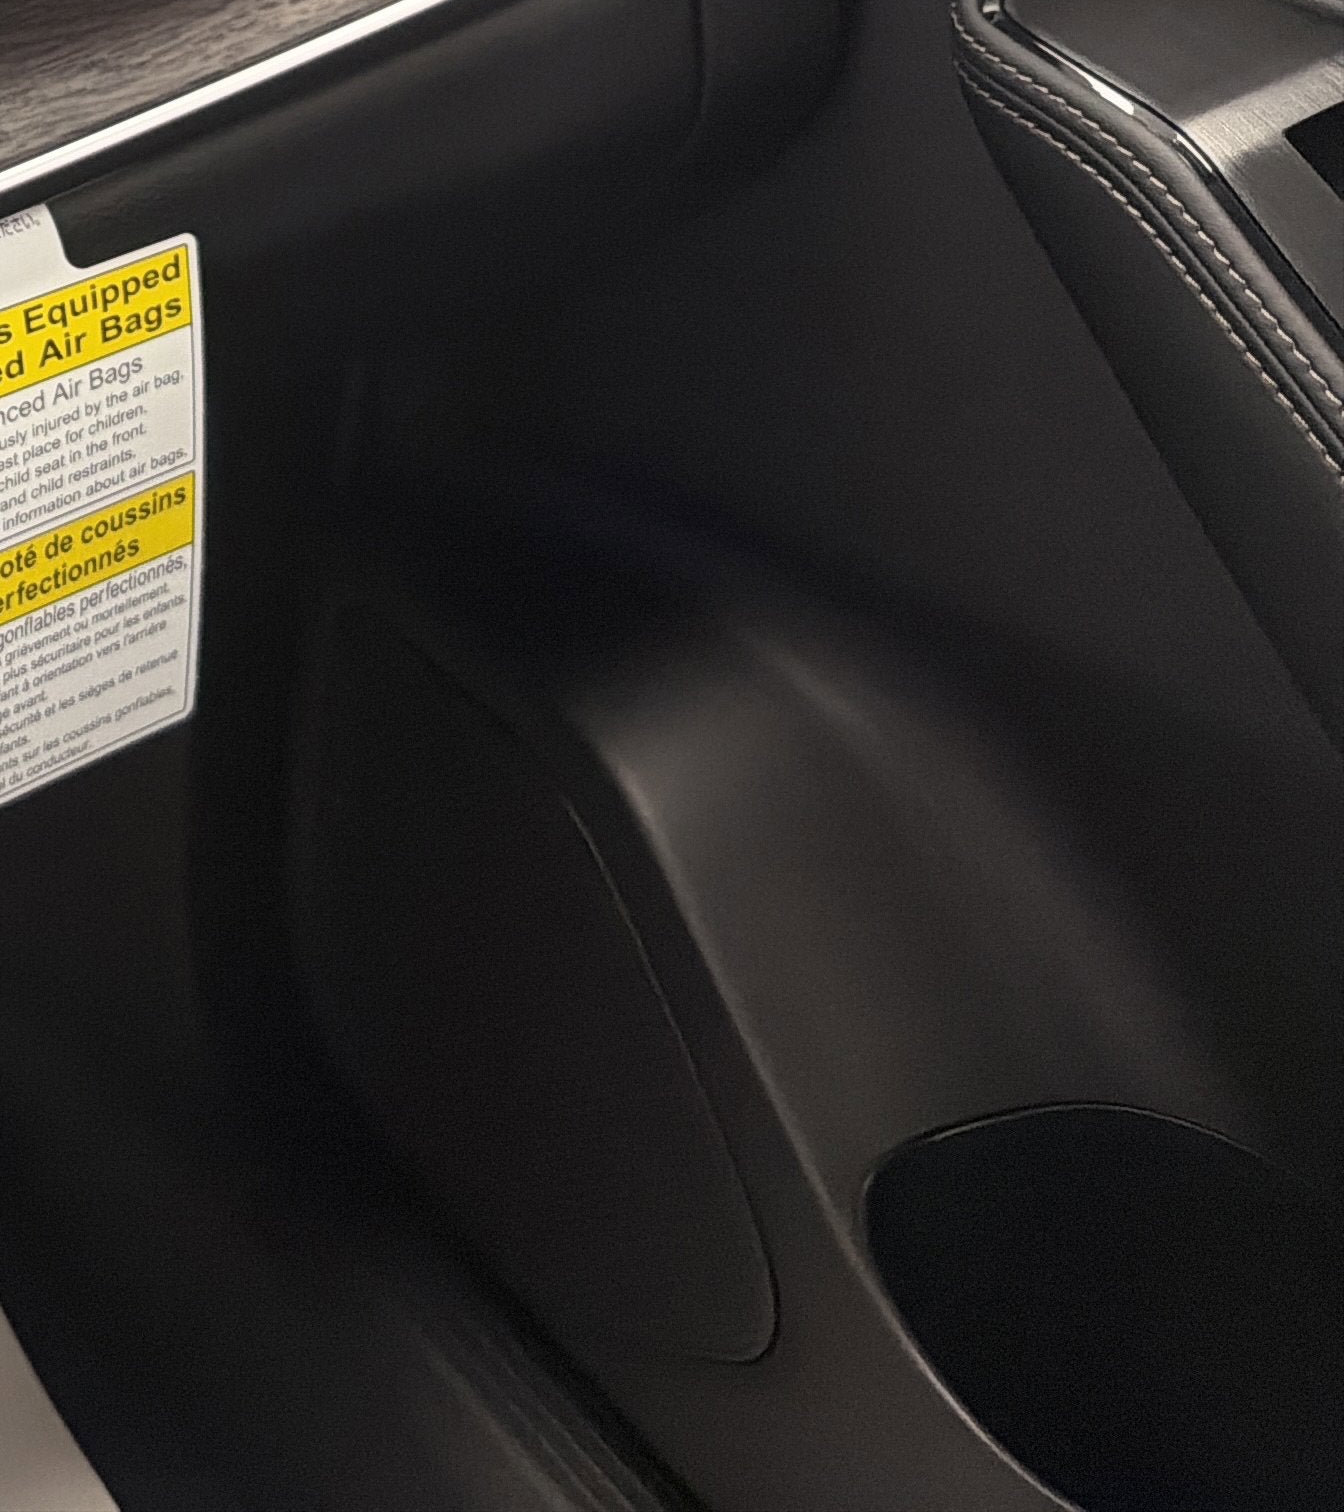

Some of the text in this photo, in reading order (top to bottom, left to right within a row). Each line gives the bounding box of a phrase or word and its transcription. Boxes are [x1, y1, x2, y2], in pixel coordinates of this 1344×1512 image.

[22, 252, 181, 335] Equipped
[38, 331, 87, 368] Air
[99, 296, 182, 344] Bags
[31, 405, 81, 438] injured
[83, 400, 101, 417] by
[104, 390, 128, 408] the
[131, 380, 150, 398] air
[153, 368, 184, 390] bag.
[51, 378, 82, 406] Air
[88, 356, 143, 391] Bags
[21, 437, 61, 465] place
[64, 426, 84, 445] for
[87, 404, 148, 436] children.
[34, 453, 66, 478] seat
[68, 449, 82, 464] in
[85, 439, 108, 457] the
[111, 421, 147, 446] front.
[0, 488, 27, 512] and
[30, 473, 64, 499] child
[67, 448, 136, 484] restraints.
[2, 489, 81, 531] information
[85, 468, 125, 496] about
[128, 461, 146, 479] air
[149, 446, 189, 470] bags.
[44, 533, 73, 560] de
[80, 485, 186, 544] coussins
[79, 554, 190, 616] perfectionnés,
